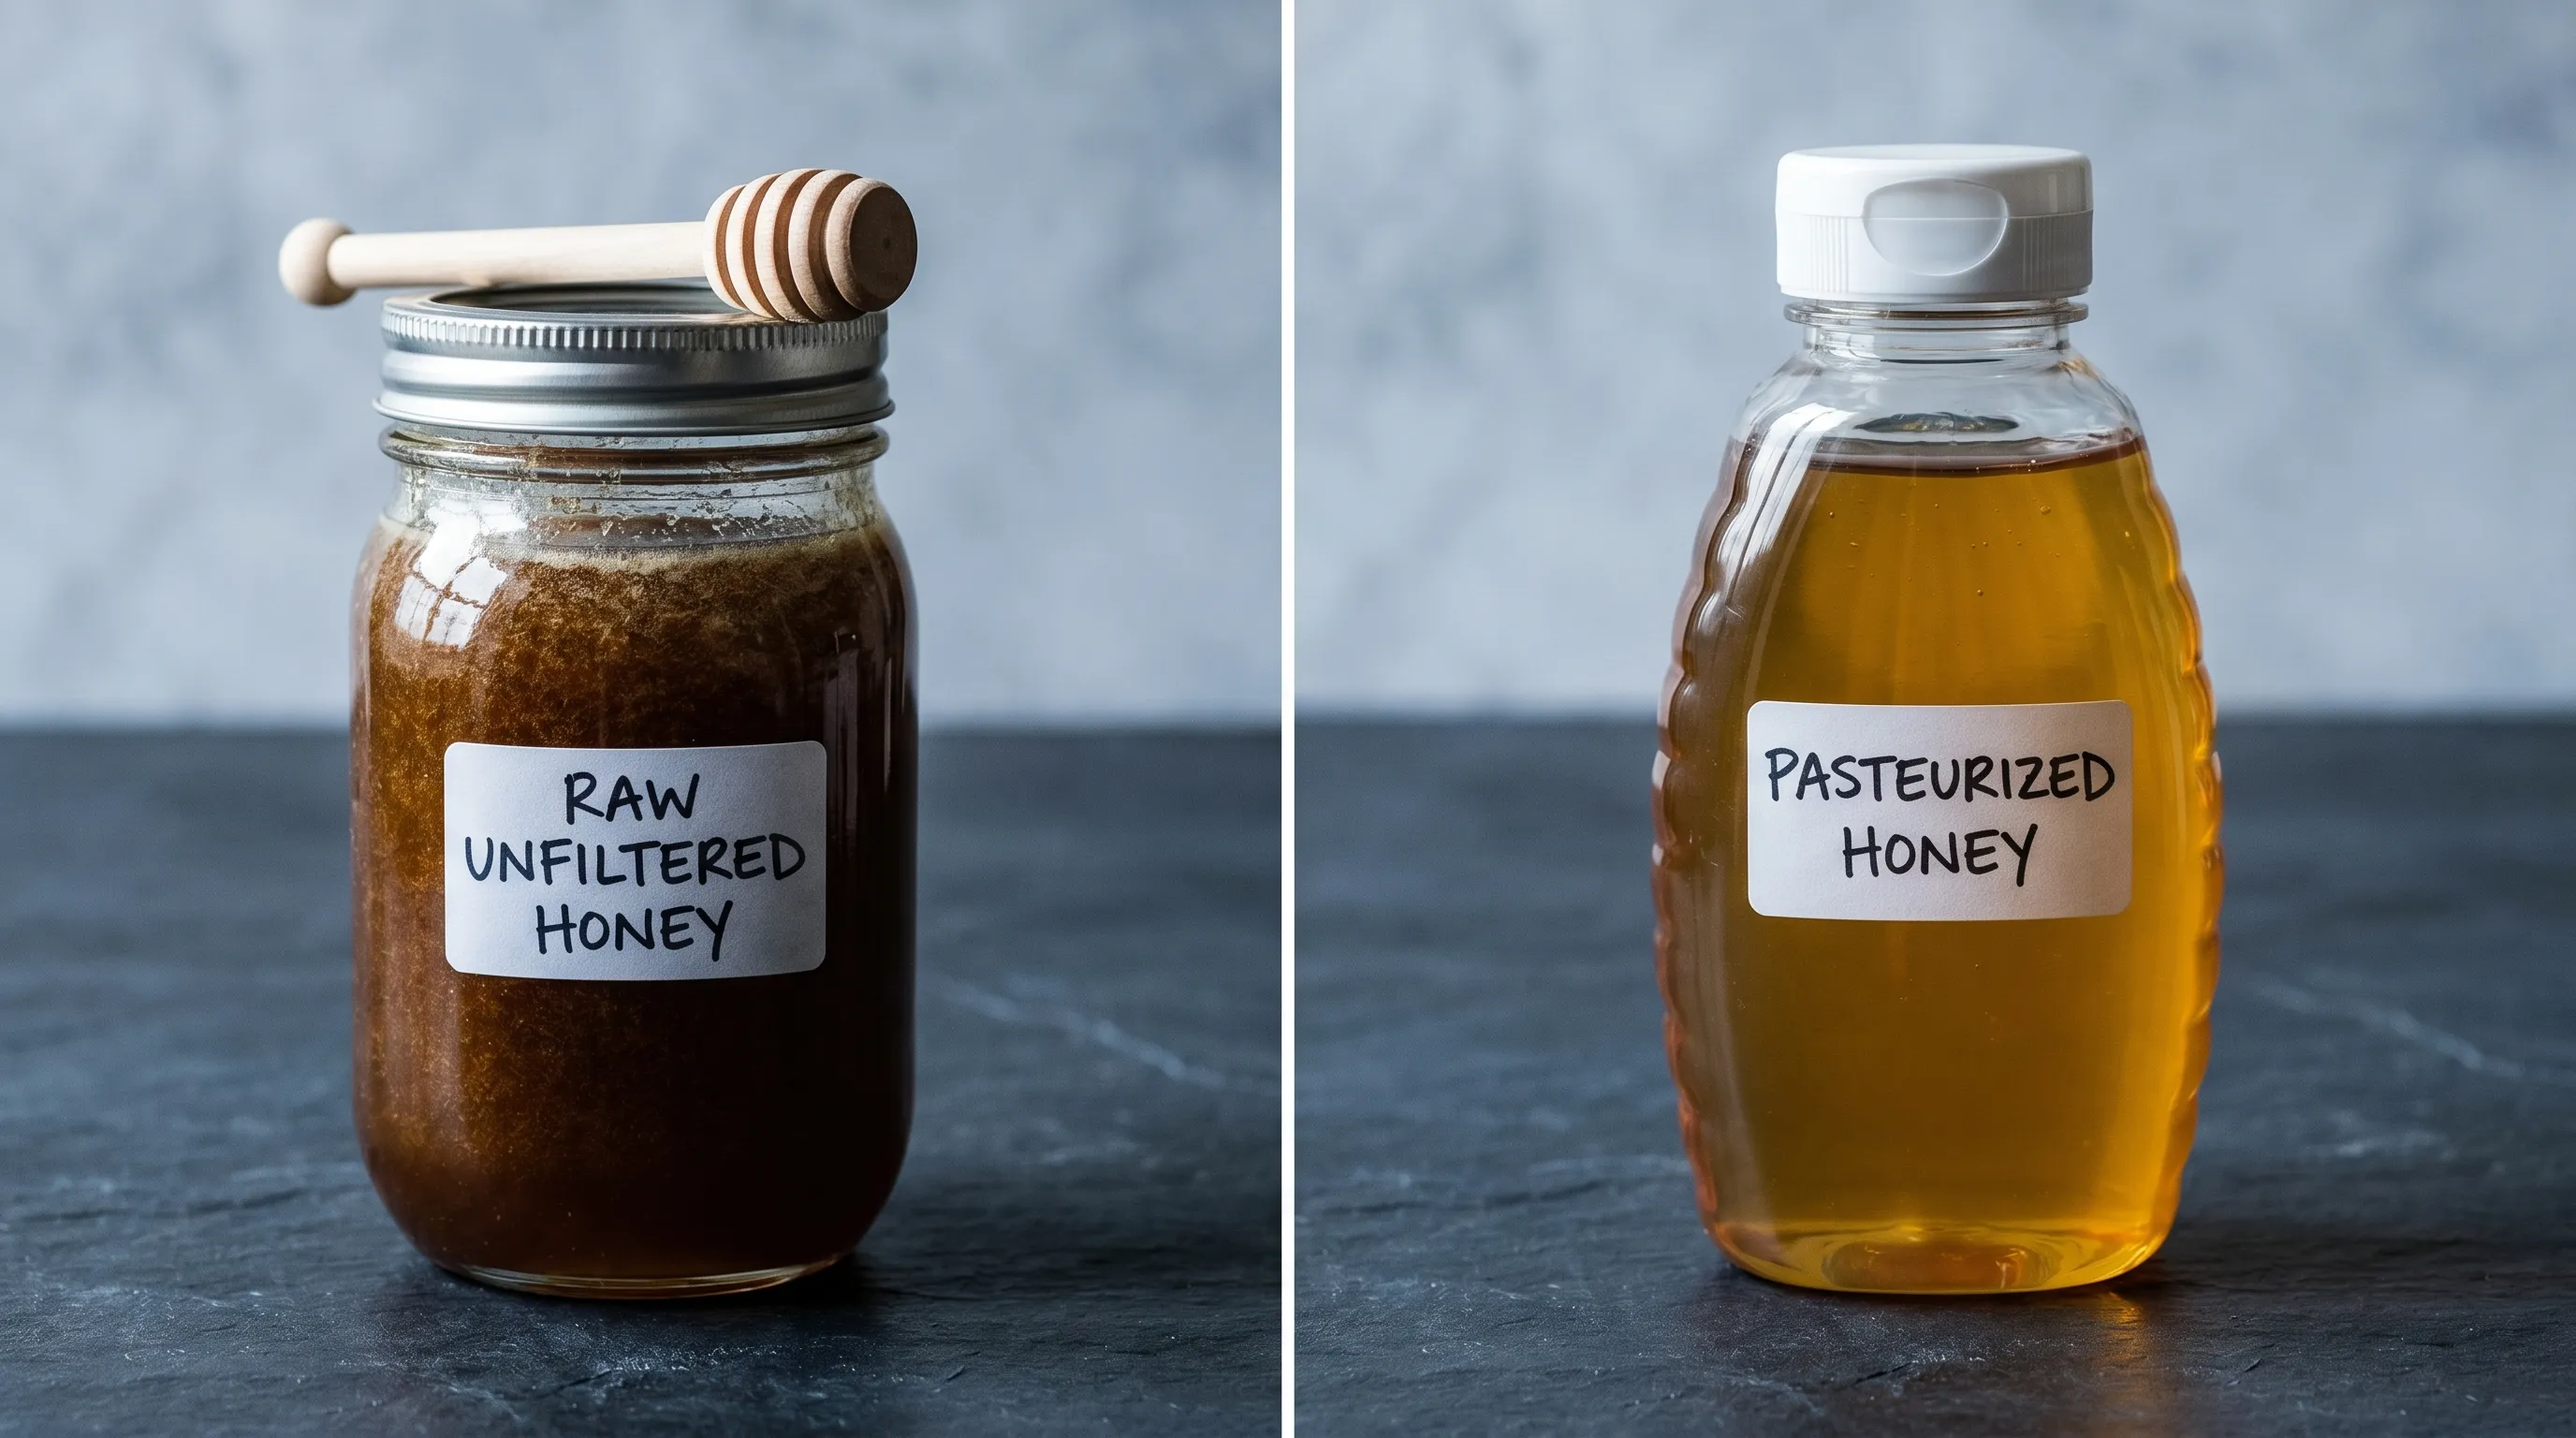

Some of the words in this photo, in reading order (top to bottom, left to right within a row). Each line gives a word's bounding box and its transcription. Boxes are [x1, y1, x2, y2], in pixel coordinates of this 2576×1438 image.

[564, 770, 702, 826] RAW
[1764, 747, 2115, 804] PASTEURIZED
[464, 834, 807, 887] UNFILTERED
[1842, 822, 2039, 888] HONEY
[535, 901, 735, 962] HONEY
